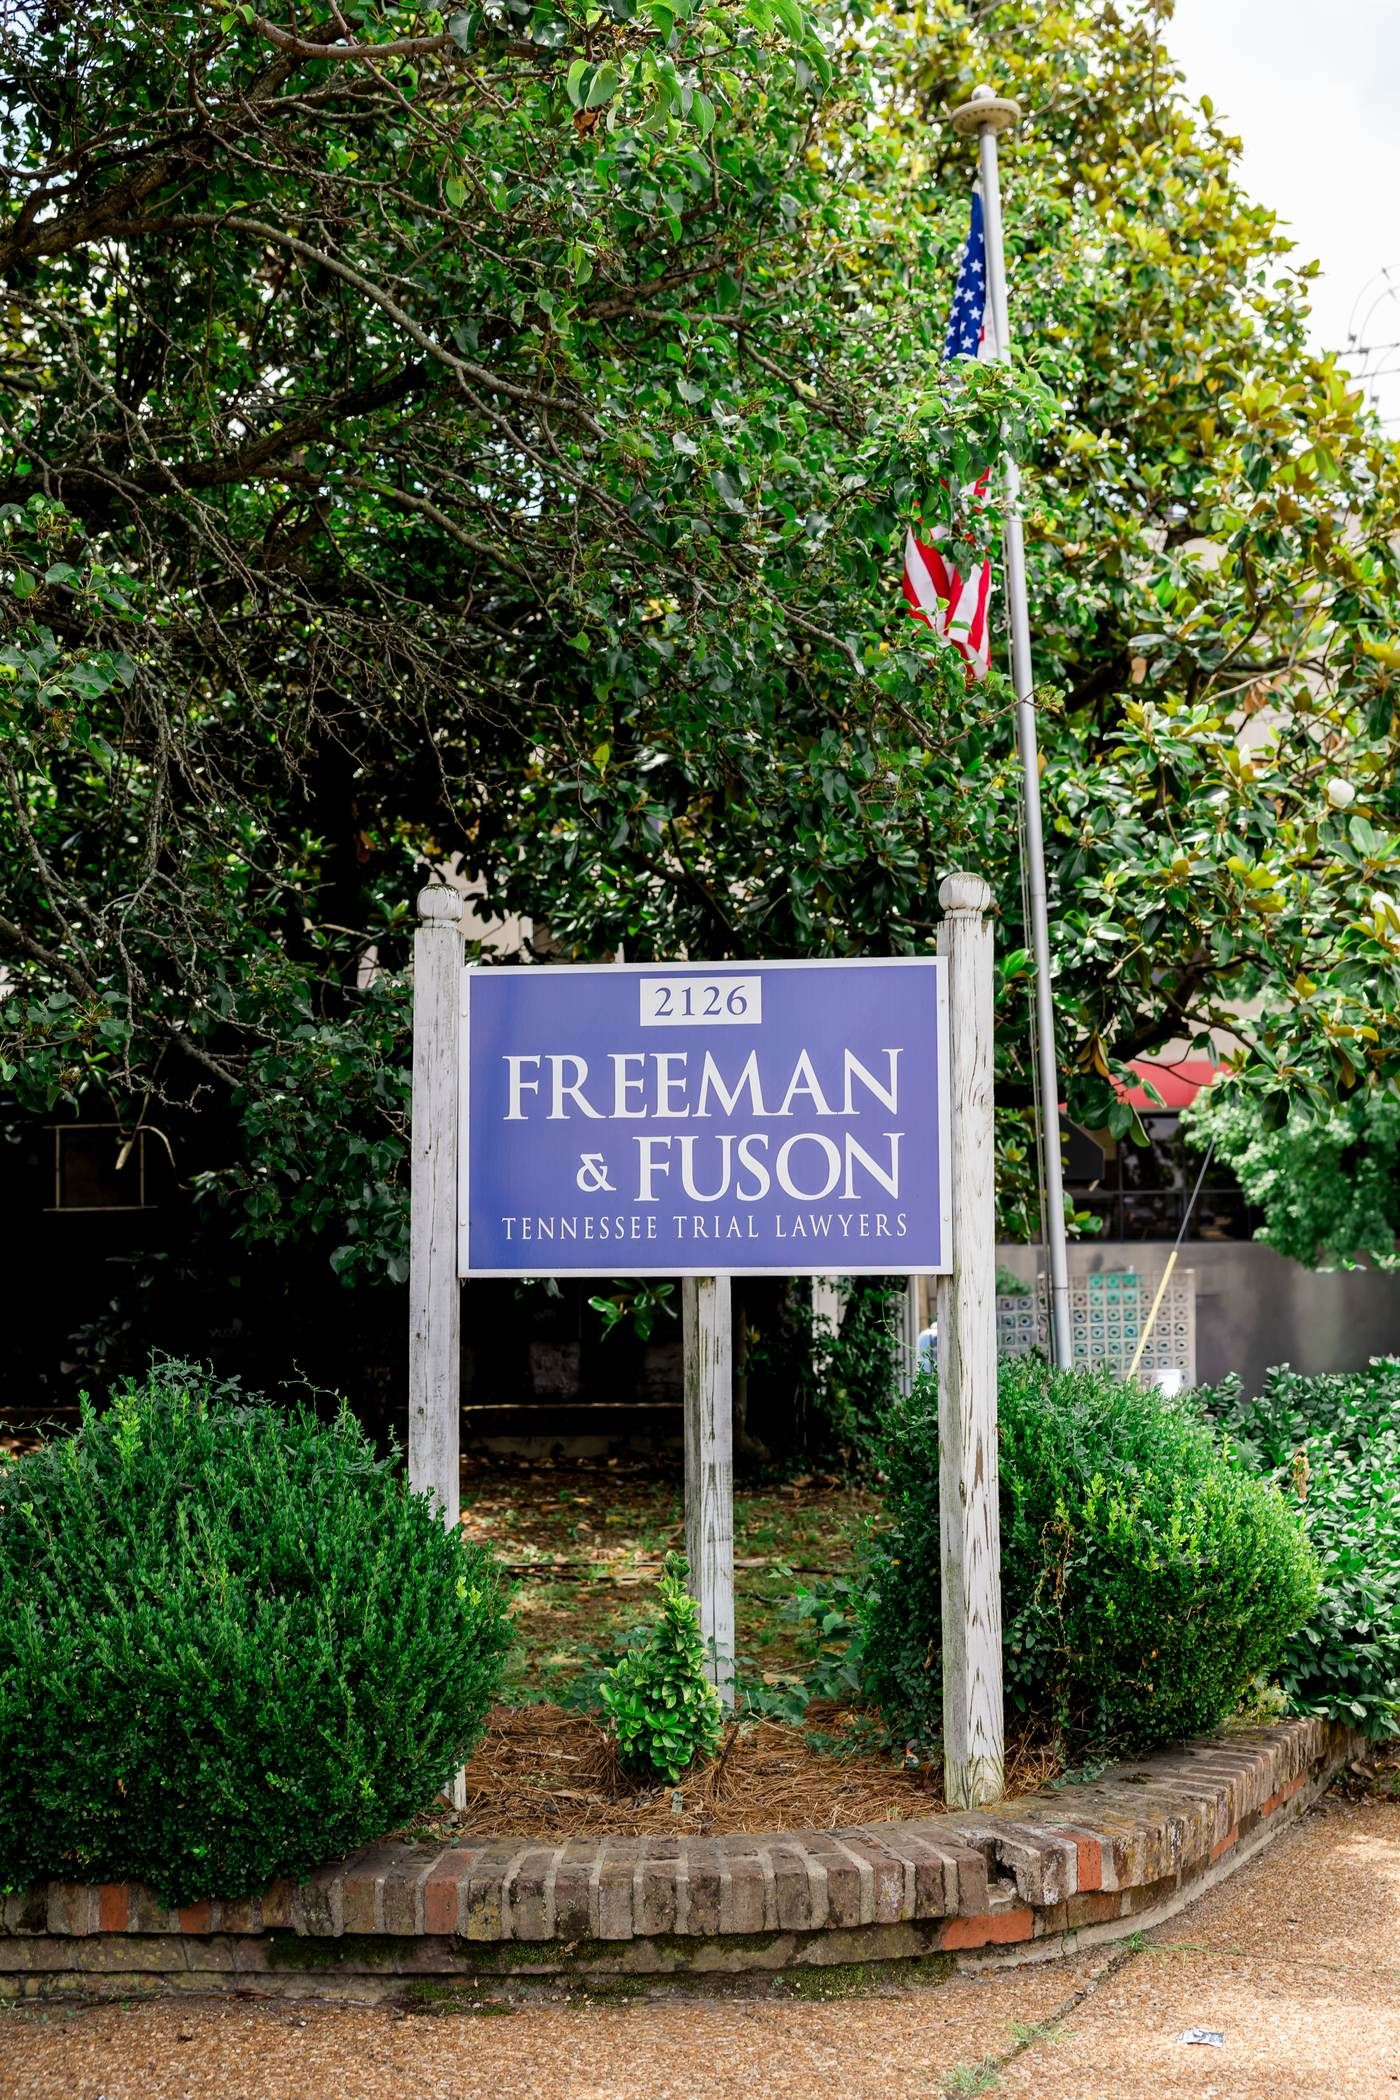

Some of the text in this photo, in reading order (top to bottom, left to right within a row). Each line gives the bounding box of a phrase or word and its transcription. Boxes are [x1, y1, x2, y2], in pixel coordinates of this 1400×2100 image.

[654, 985, 748, 1017] 2126
[502, 1048, 904, 1120] FREEMAN
[576, 1132, 905, 1202] & FUSON
[501, 1213, 908, 1240] TENNESSEE TRIAL LAWYERS
